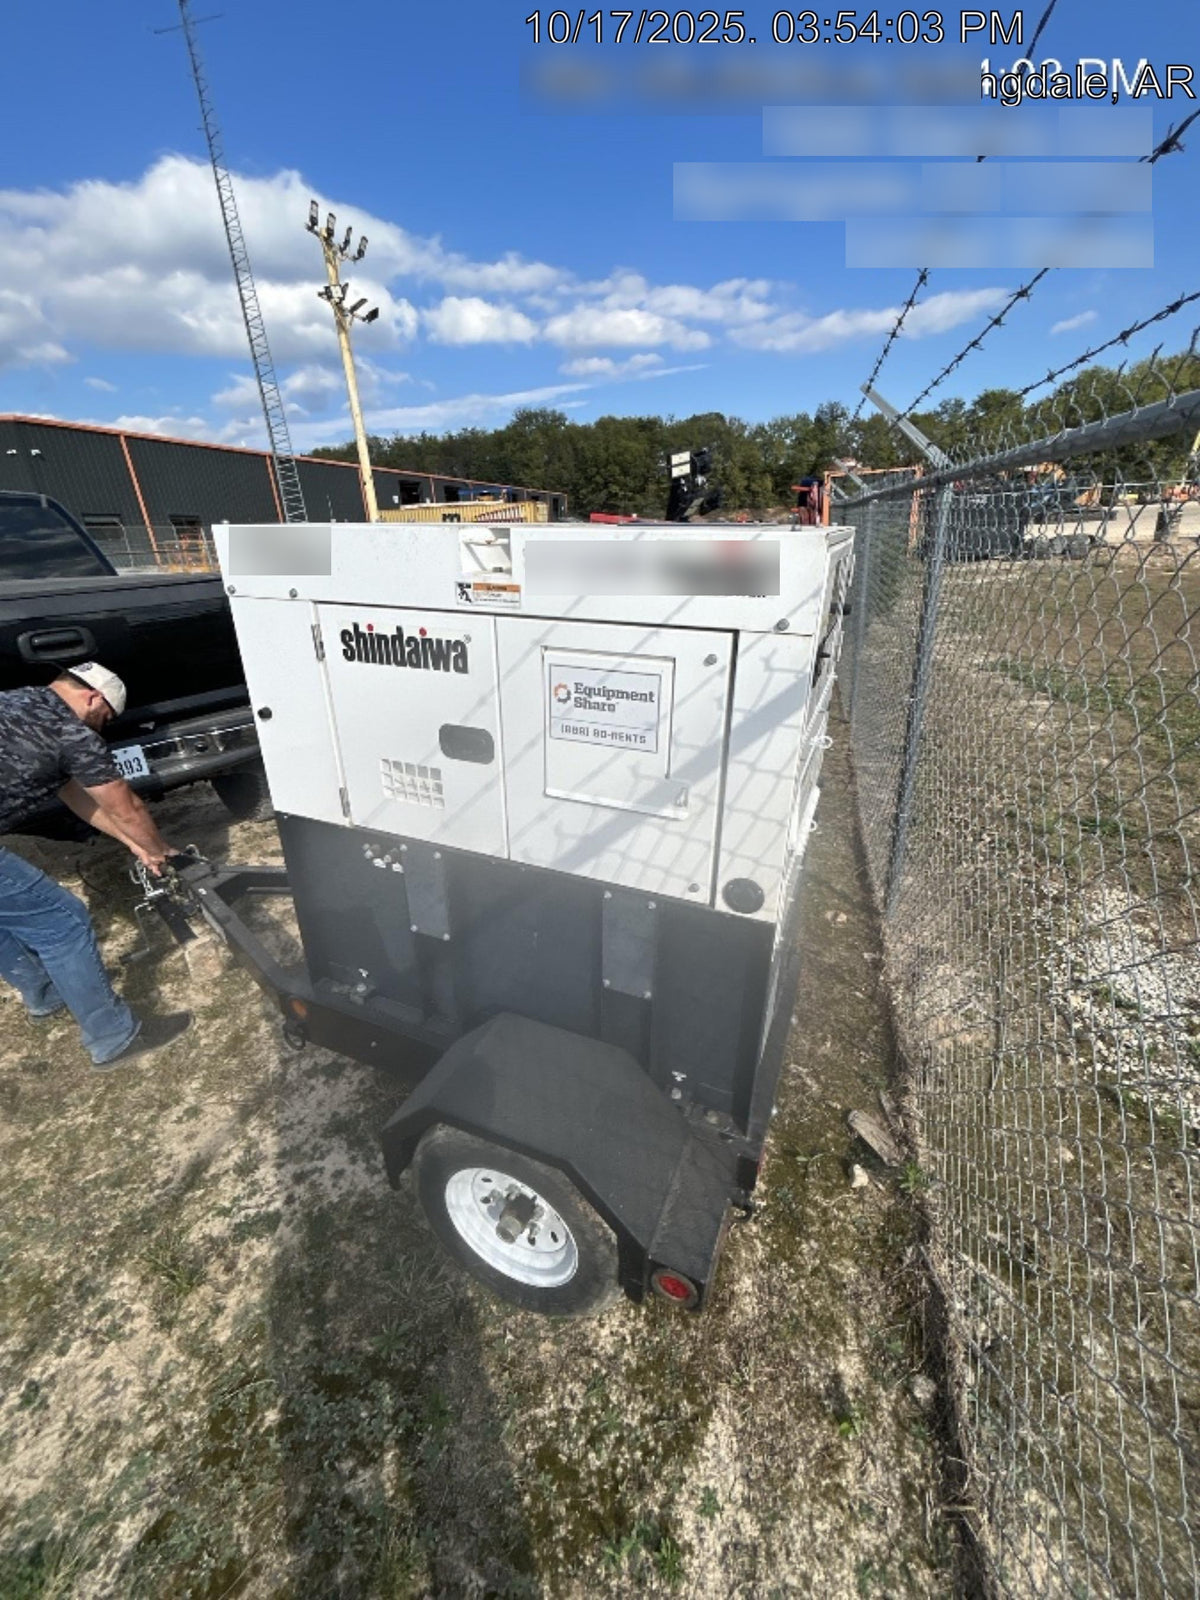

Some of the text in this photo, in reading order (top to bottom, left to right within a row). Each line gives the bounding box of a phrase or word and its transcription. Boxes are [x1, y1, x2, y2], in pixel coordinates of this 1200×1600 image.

[340, 622, 469, 674] shindaiwa
[573, 682, 656, 703] Equipment
[573, 696, 617, 713] Share
